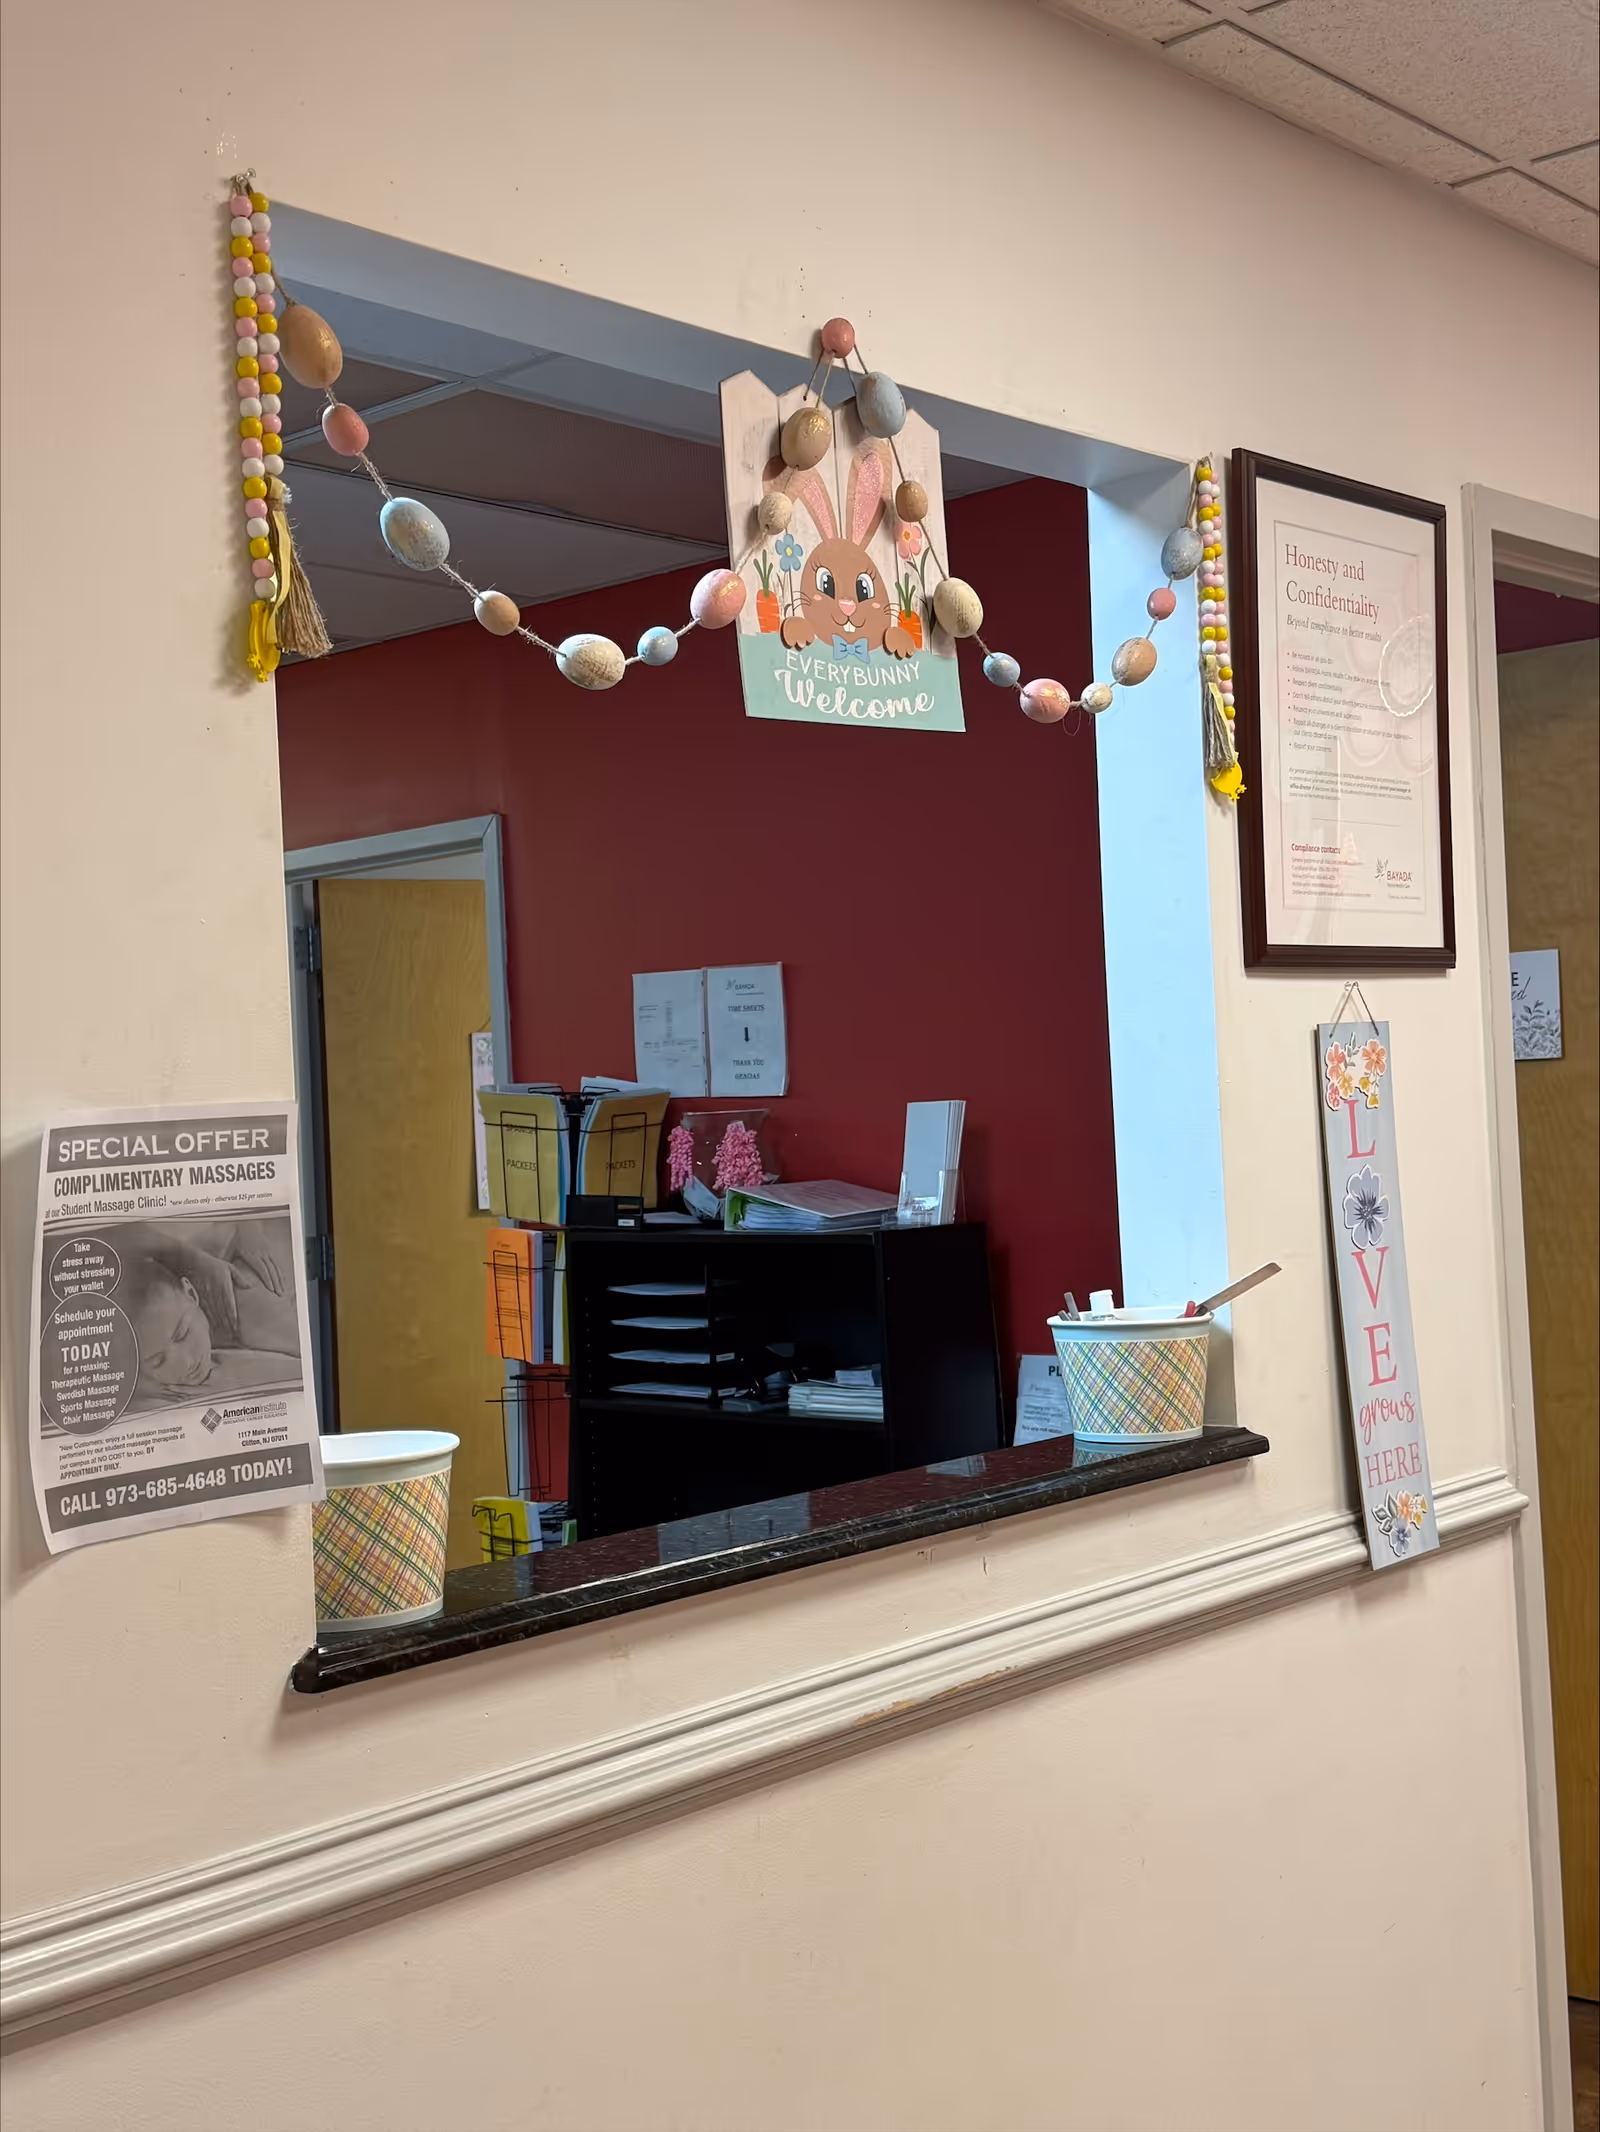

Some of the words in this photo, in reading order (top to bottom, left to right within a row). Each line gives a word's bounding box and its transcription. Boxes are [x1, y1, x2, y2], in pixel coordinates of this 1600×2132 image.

[1285, 544, 1339, 581] Honesty
[1343, 560, 1365, 581] and
[1286, 580, 1380, 624] Confidentiality
[1287, 614, 1309, 629] Beyond
[1310, 620, 1340, 634] compliance
[1342, 626, 1348, 635] to
[773, 669, 935, 719] Welcome
[1291, 843, 1320, 853] Compliance
[1387, 870, 1412, 881] BAYADA
[58, 1136, 169, 1163] SPECIAL
[175, 1128, 269, 1154] OFFER
[507, 1159, 537, 1171] PACKETS
[54, 1167, 184, 1197] COMPLIMENTARY
[190, 1161, 276, 1185] MASSAGES
[51, 1209, 61, 1218] our
[61, 1199, 92, 1216] Student
[94, 1197, 135, 1213] Massage
[138, 1195, 167, 1208] Clinic!
[200, 1196, 210, 1204] only
[73, 1243, 91, 1253] Take
[62, 1257, 83, 1268] stress
[84, 1255, 104, 1265] away
[54, 1270, 80, 1282] without
[80, 1267, 115, 1278] stressing
[64, 1284, 79, 1296] your
[81, 1281, 104, 1292] wallet
[54, 1309, 93, 1324] Schedule
[95, 1307, 116, 1320] your
[58, 1322, 113, 1341] appointment
[61, 1341, 111, 1363] TODAY
[63, 1366, 73, 1375] for
[80, 1361, 110, 1372] relaxing:
[51, 1375, 91, 1390] Therapeutic
[92, 1372, 125, 1383] Massage
[56, 1388, 86, 1402] Swedish
[87, 1384, 119, 1396] Massage
[60, 1402, 83, 1414] Sports
[84, 1397, 117, 1409] Massage
[62, 1415, 81, 1425] Chair
[82, 1410, 115, 1421] Massage
[1358, 1391, 1415, 1446] grows
[105, 1436, 121, 1444] enjoy
[136, 1430, 157, 1439] session
[157, 1426, 183, 1435] massage
[238, 1431, 251, 1439] 1117
[252, 1429, 266, 1437] Main
[266, 1426, 288, 1434] Avenue
[241, 1439, 262, 1447] Clifton,
[270, 1434, 288, 1443] 07011
[59, 1450, 86, 1462] performed
[86, 1448, 94, 1456] by
[105, 1443, 126, 1452] student
[126, 1440, 151, 1449] massage
[152, 1434, 179, 1444] therapists
[69, 1459, 90, 1469] campus
[97, 1455, 108, 1463] NO
[108, 1451, 126, 1461] COST
[133, 1449, 145, 1459] you.
[146, 1446, 155, 1454] BY
[1364, 1441, 1423, 1488] HERE
[60, 1465, 102, 1480] APPOINTMENT
[103, 1462, 122, 1471] ONLY.
[60, 1491, 101, 1516] CALL
[105, 1468, 227, 1508] 973-685-4648
[230, 1456, 293, 1483] TODAY!
